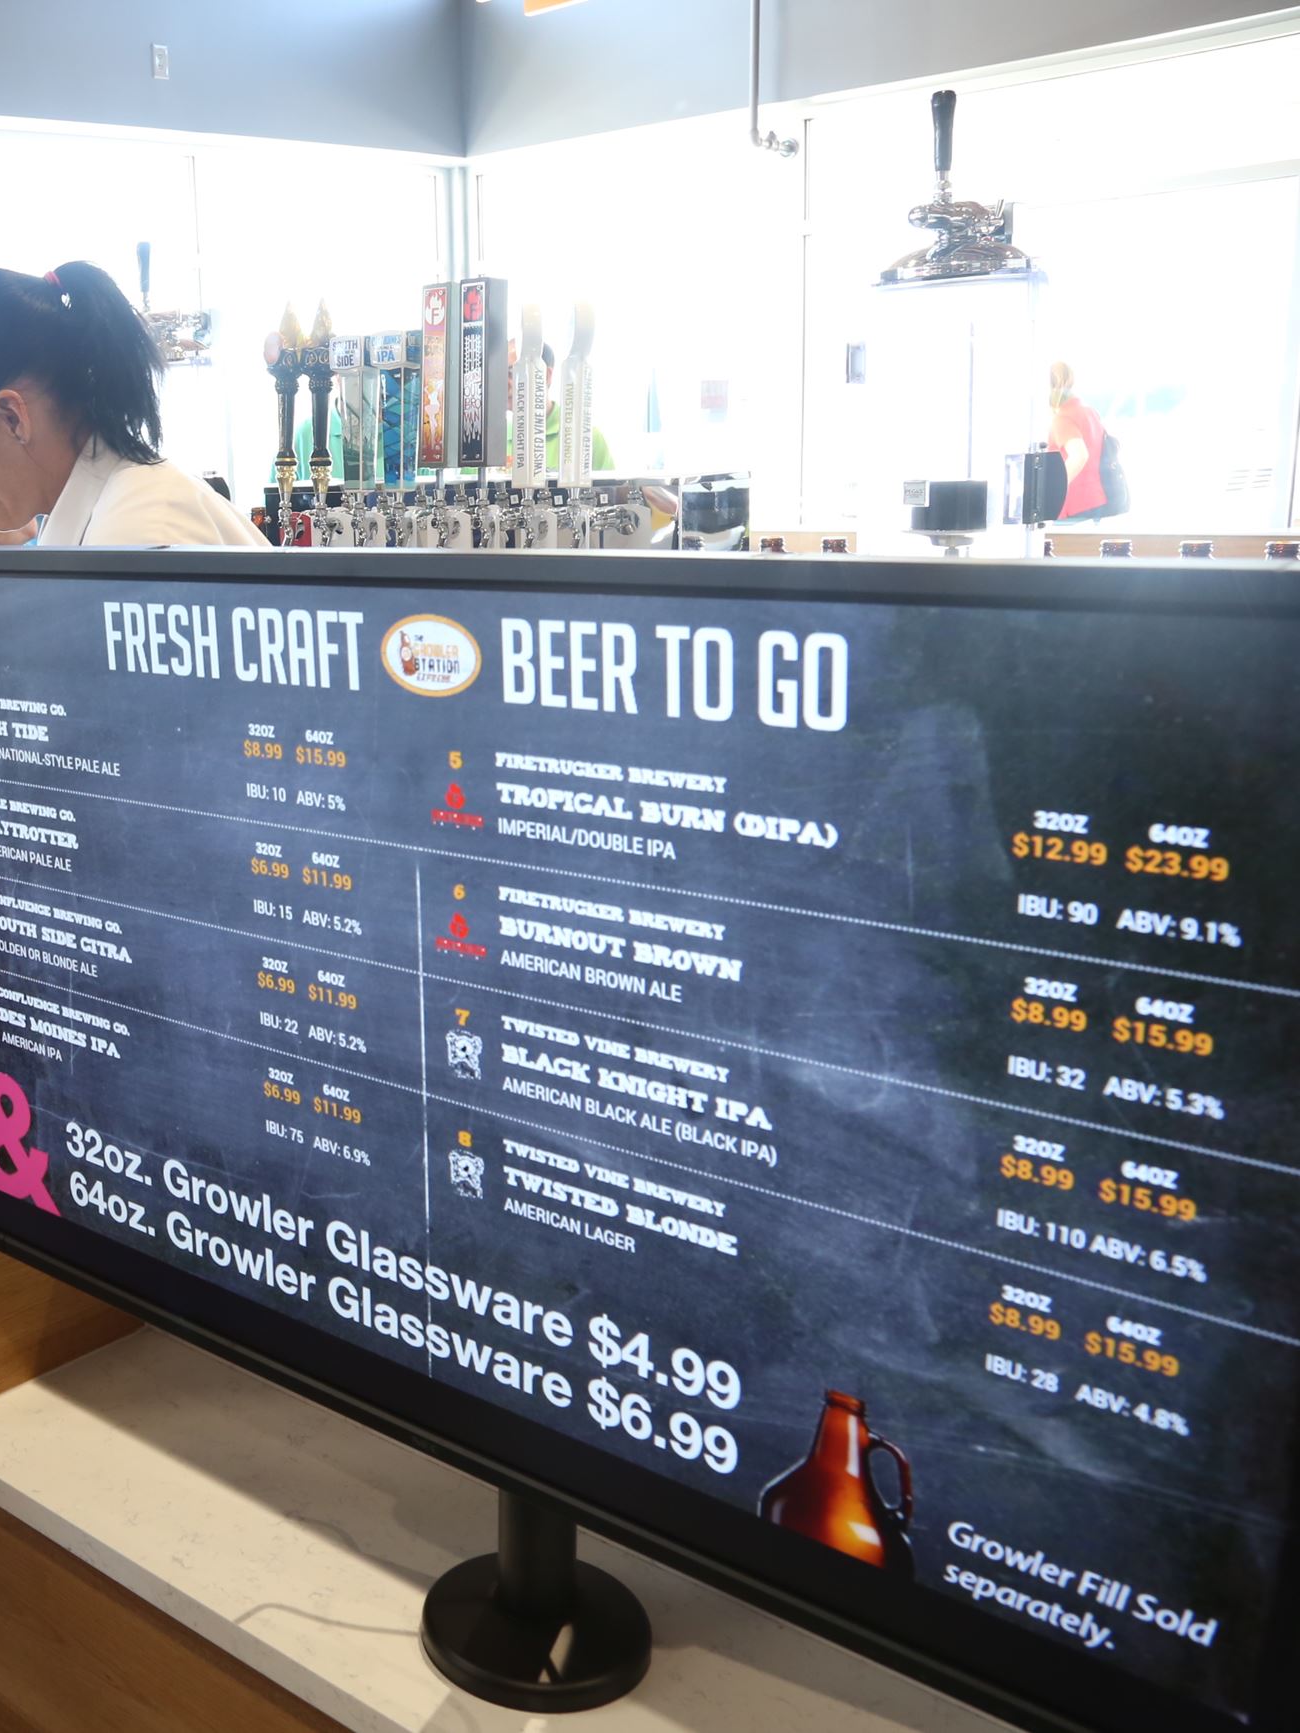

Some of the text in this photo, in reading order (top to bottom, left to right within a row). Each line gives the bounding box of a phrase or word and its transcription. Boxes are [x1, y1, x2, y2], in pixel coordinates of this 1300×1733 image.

[336, 354, 354, 367] SIDE
[377, 350, 395, 362] IPA
[103, 601, 364, 692] FRESH CRAFT
[500, 617, 848, 732] BEER TO GO
[0, 698, 48, 714] BREWING
[49, 704, 67, 716] CO.
[12, 722, 49, 741] TIDE
[243, 739, 347, 768] $8.99 $15.99
[75, 757, 100, 774] PALE
[101, 761, 121, 777] ALE
[449, 751, 463, 769] 5
[496, 752, 727, 794] FIRETRUCKER BREWERY
[246, 782, 346, 811] IBU: 10 ABV: 5%
[496, 783, 633, 821] TROPICAL
[639, 800, 726, 833] BURN
[733, 811, 839, 849] (DIPA)
[498, 817, 643, 856] IMPERIAL/DOUBLE
[647, 839, 677, 861] IPA
[1012, 832, 1229, 882] $12.99 $23.99
[30, 852, 53, 867] PALE
[54, 857, 72, 872] ALE
[453, 884, 466, 899] 6
[53, 908, 103, 930] BREWING
[105, 920, 122, 935] CO.
[1017, 893, 1242, 948] IBU: 90 ABV: 9.1%
[28, 948, 41, 962] OR
[42, 952, 78, 972] BLONDE
[80, 961, 98, 978] ALE
[41, 926, 77, 949] SIDE
[80, 936, 132, 964] CITRA
[500, 916, 743, 981] BURNOUT BROWN
[500, 949, 683, 1003] AMERICAN BROWN ALE
[0, 1008, 121, 1059] DES MOINES IPA
[455, 1009, 470, 1026] 7
[2, 1031, 63, 1062] AMERICAN IPA
[501, 1016, 730, 1084] TWISTED VINE BREWERY
[501, 1044, 773, 1131] BLACK KNIGHT IPA
[457, 1131, 473, 1147] 8
[502, 1076, 778, 1168] AMERICAN BLACK ALE (BLACK IPA)
[503, 1166, 738, 1257] TWISTED BLONDE
[504, 1197, 636, 1253] AMERICAN LAGER
[65, 1121, 741, 1412] 32oz. Growler Glassware $4.99
[69, 1170, 739, 1475] 64oz. Growler Glassware $6.99
[948, 1520, 1218, 1647] Growler Fill Sold
[943, 1563, 1116, 1650] separately.
